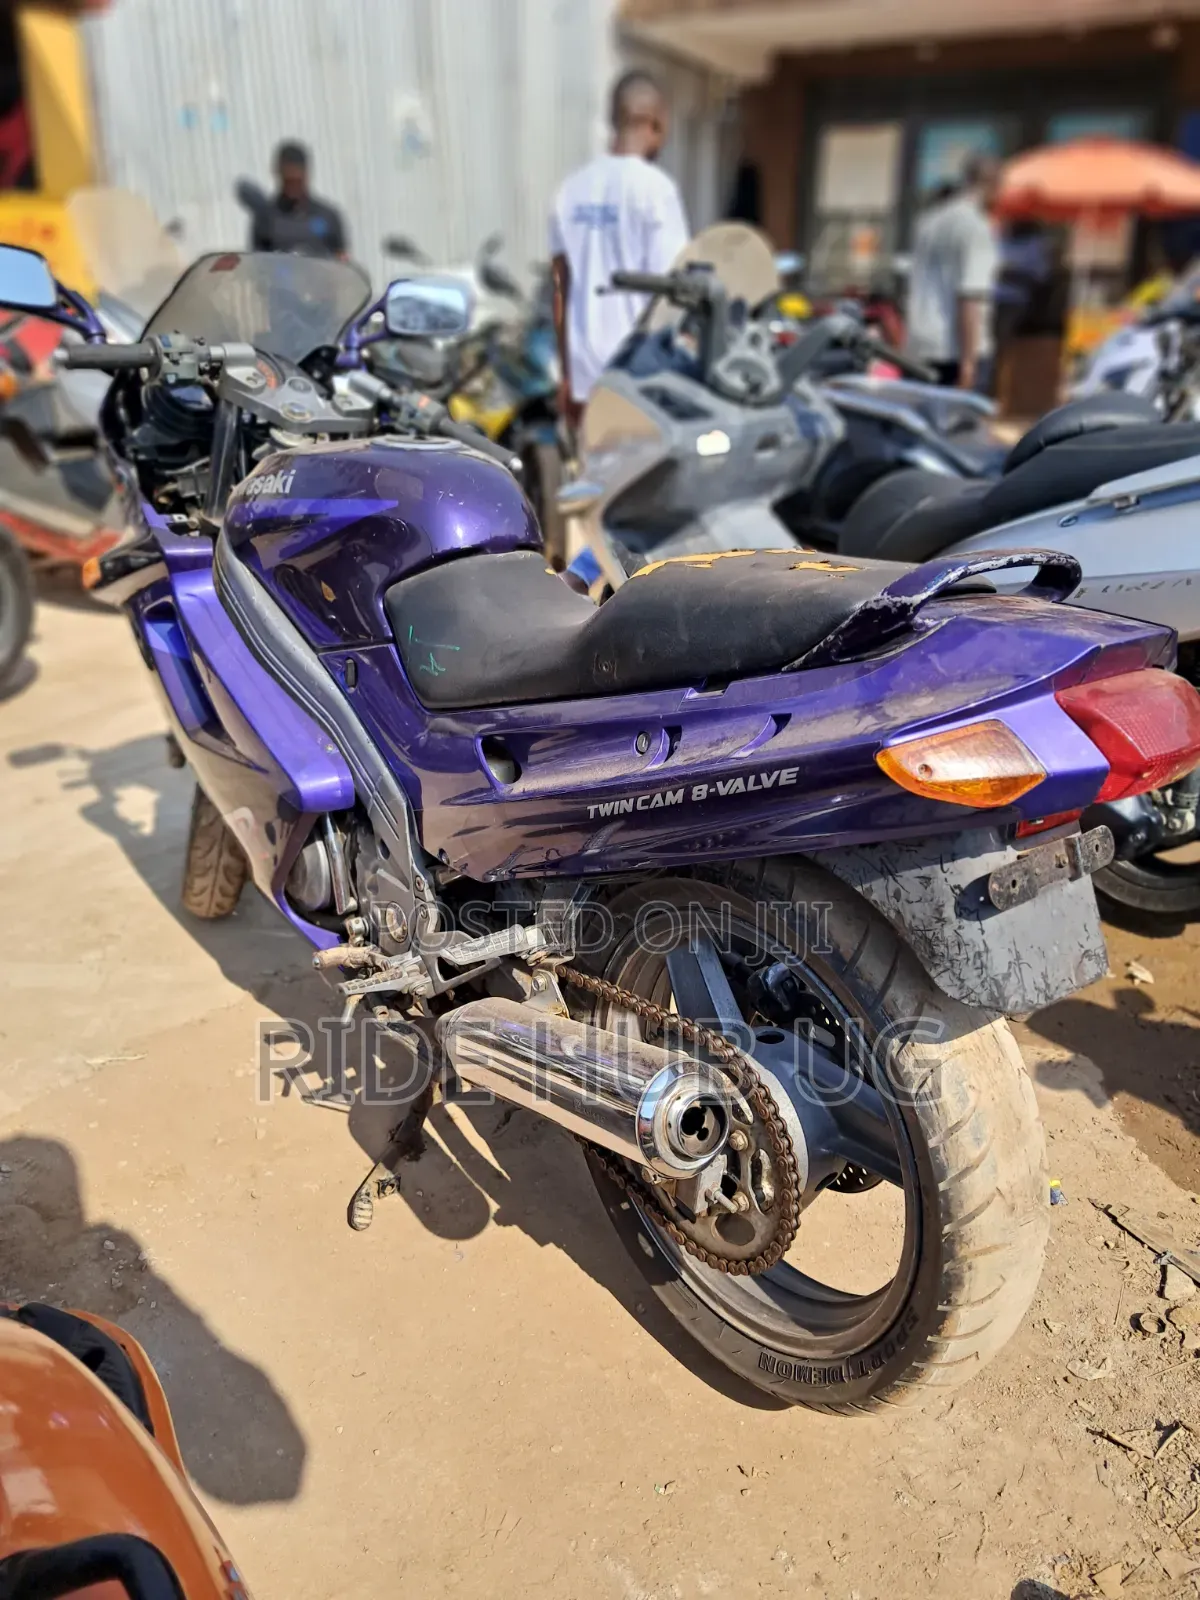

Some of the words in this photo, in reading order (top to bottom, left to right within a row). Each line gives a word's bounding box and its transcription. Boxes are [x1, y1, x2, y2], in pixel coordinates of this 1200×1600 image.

[586, 798, 634, 819] TWIN
[636, 788, 684, 811] CAM
[691, 766, 800, 801] 8-VALVE
[758, 1351, 846, 1385] DEMON
